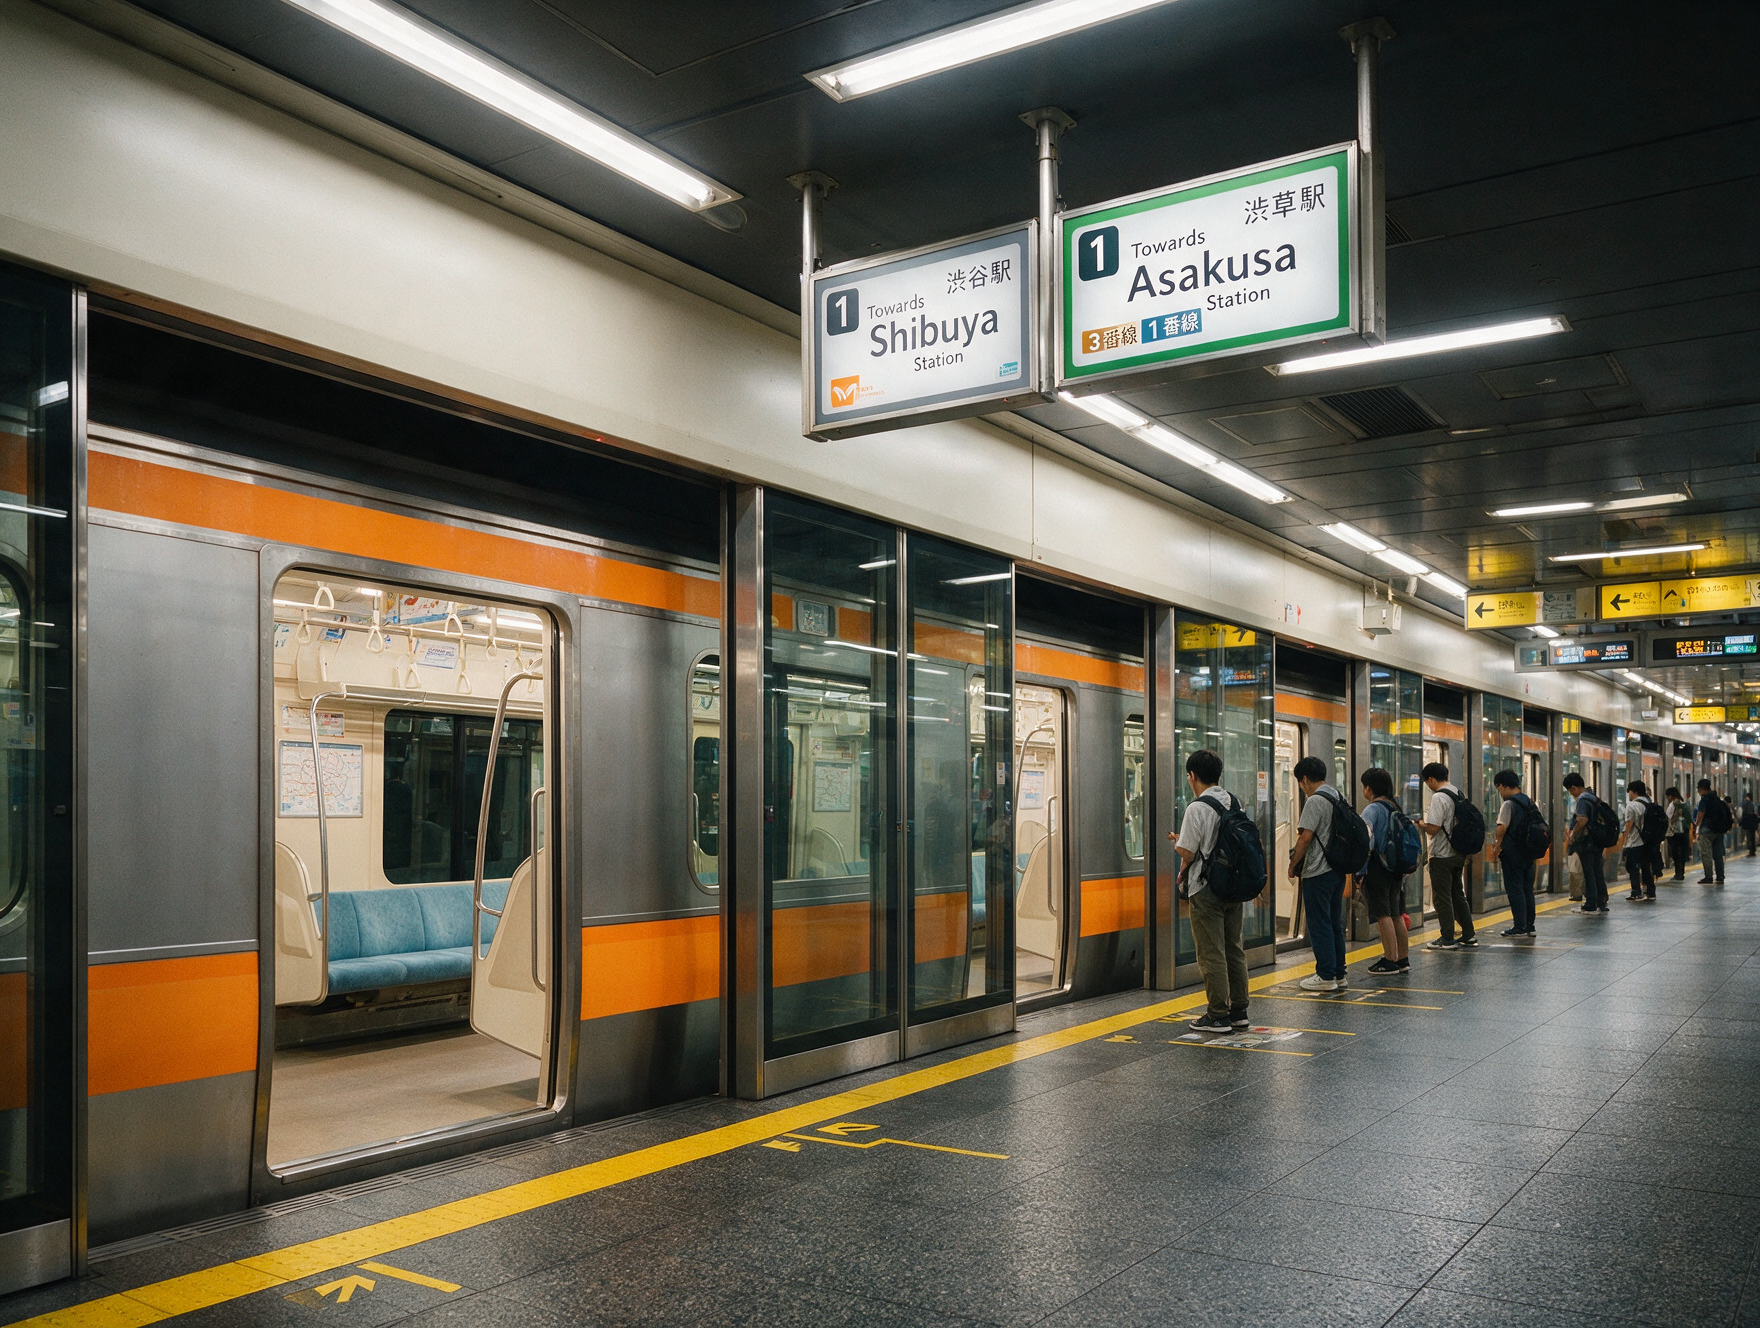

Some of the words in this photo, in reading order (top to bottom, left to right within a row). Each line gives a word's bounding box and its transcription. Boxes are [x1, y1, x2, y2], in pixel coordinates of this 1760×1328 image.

[1245, 183, 1326, 225] 渋草駅
[1089, 234, 1105, 272] 1
[1131, 228, 1206, 259] Towards
[946, 258, 1012, 294] 渋谷駅
[1127, 243, 1297, 303] Asakusa
[835, 294, 847, 328] 1
[866, 293, 925, 320] Towards
[1206, 287, 1271, 311] Station
[870, 308, 999, 358] Shibuya
[913, 352, 964, 372] Station
